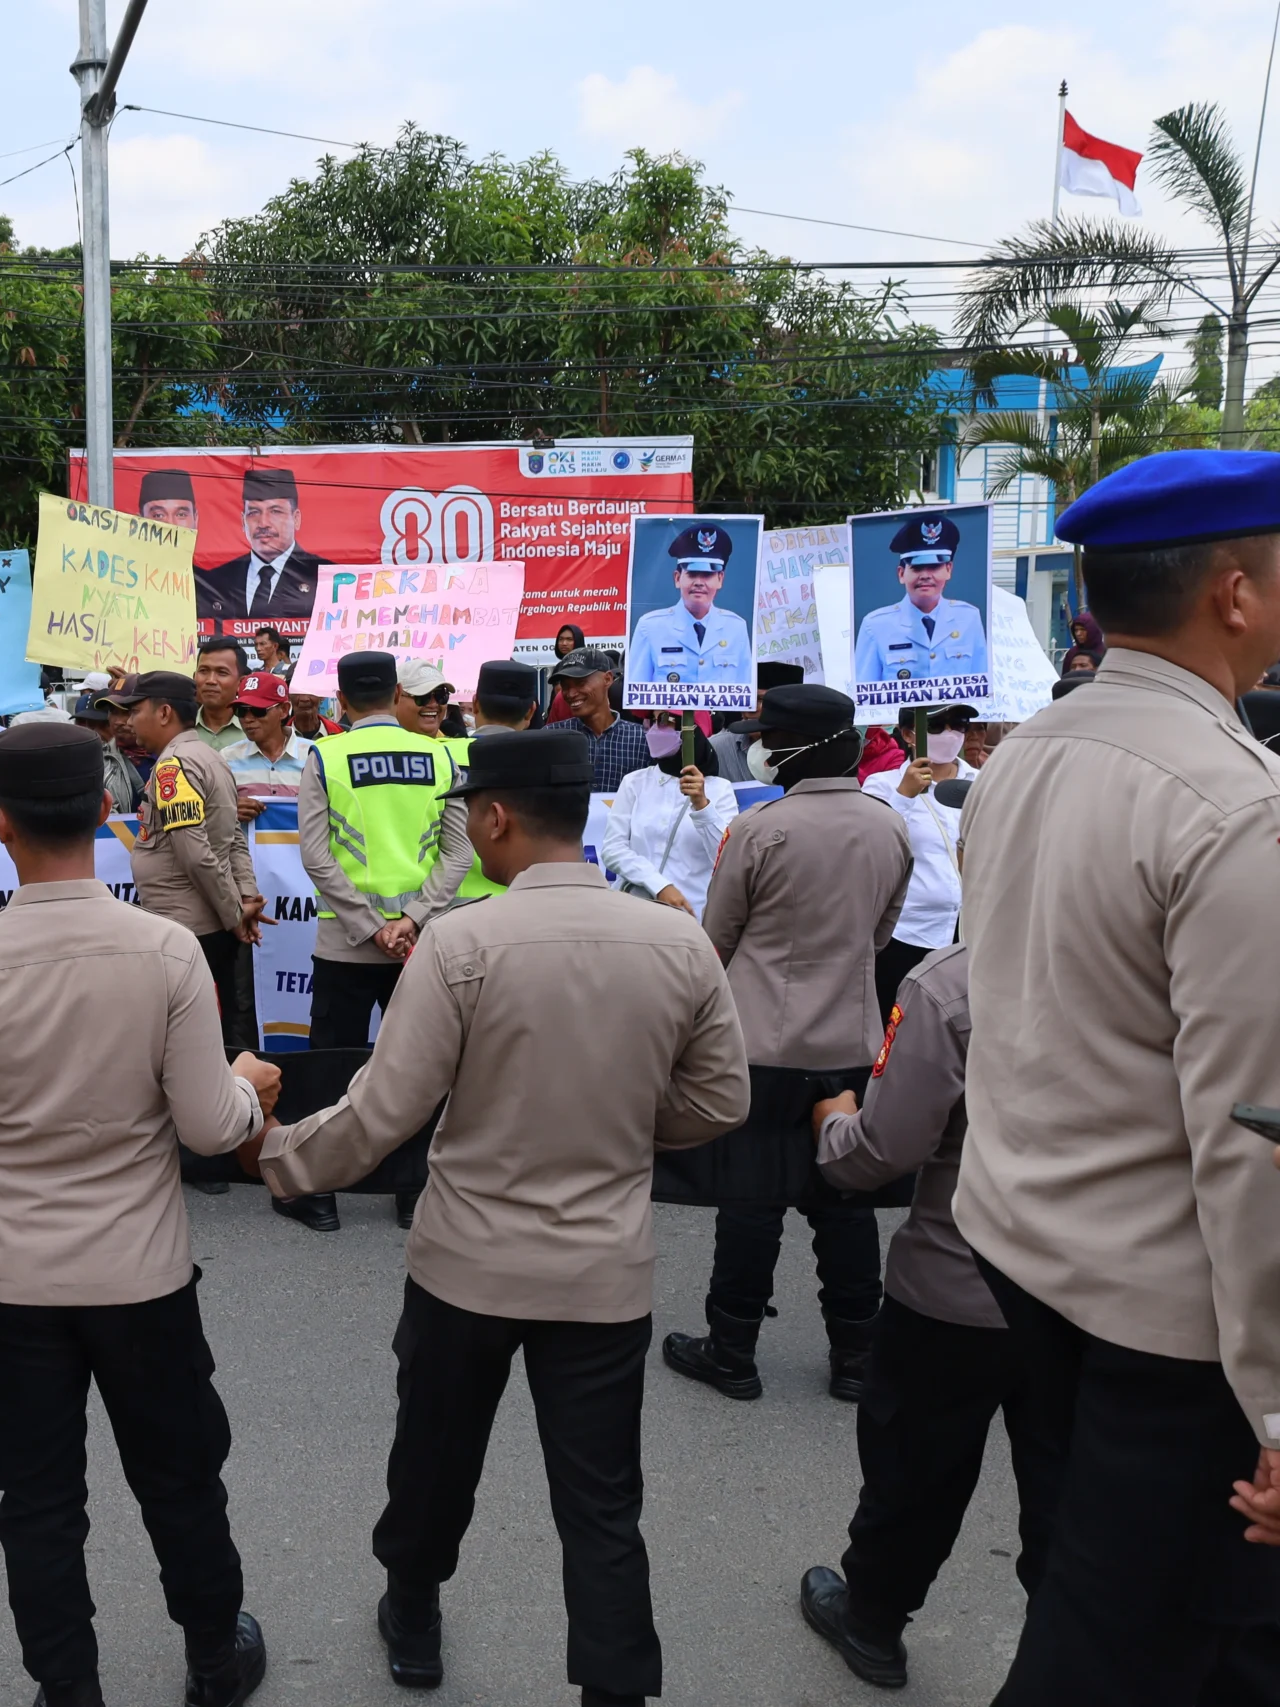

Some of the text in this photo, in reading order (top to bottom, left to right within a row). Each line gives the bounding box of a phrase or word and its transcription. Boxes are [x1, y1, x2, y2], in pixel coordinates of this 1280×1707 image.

[548, 464, 576, 474] GAS
[500, 500, 646, 518] Bersatu Berdaulat
[66, 502, 180, 548] ORASI DAMAI
[380, 485, 494, 564] 80
[500, 522, 556, 541] Rakyat
[501, 540, 621, 560] Indonesia Maju
[770, 527, 840, 554] DAMAI
[62, 543, 190, 602] KADES KAMI
[332, 566, 490, 604] PERKARA
[550, 588, 580, 598] untuk
[583, 586, 618, 596] meraih
[81, 584, 150, 620] NYATA
[520, 603, 564, 616] irgahayu
[567, 602, 610, 614] Republik
[316, 604, 518, 631] INI MENGHAMBAT
[47, 610, 196, 665] HASIL KERJA
[332, 624, 468, 652] KEMAJUAN
[628, 684, 752, 694] INILAH KEPALA DESA
[856, 674, 988, 693] INILAH KEPALA DESA
[856, 684, 989, 706] PILIHAN KAMI
[628, 694, 752, 708] PILIHAN KAMI
[351, 756, 433, 782] POLISI
